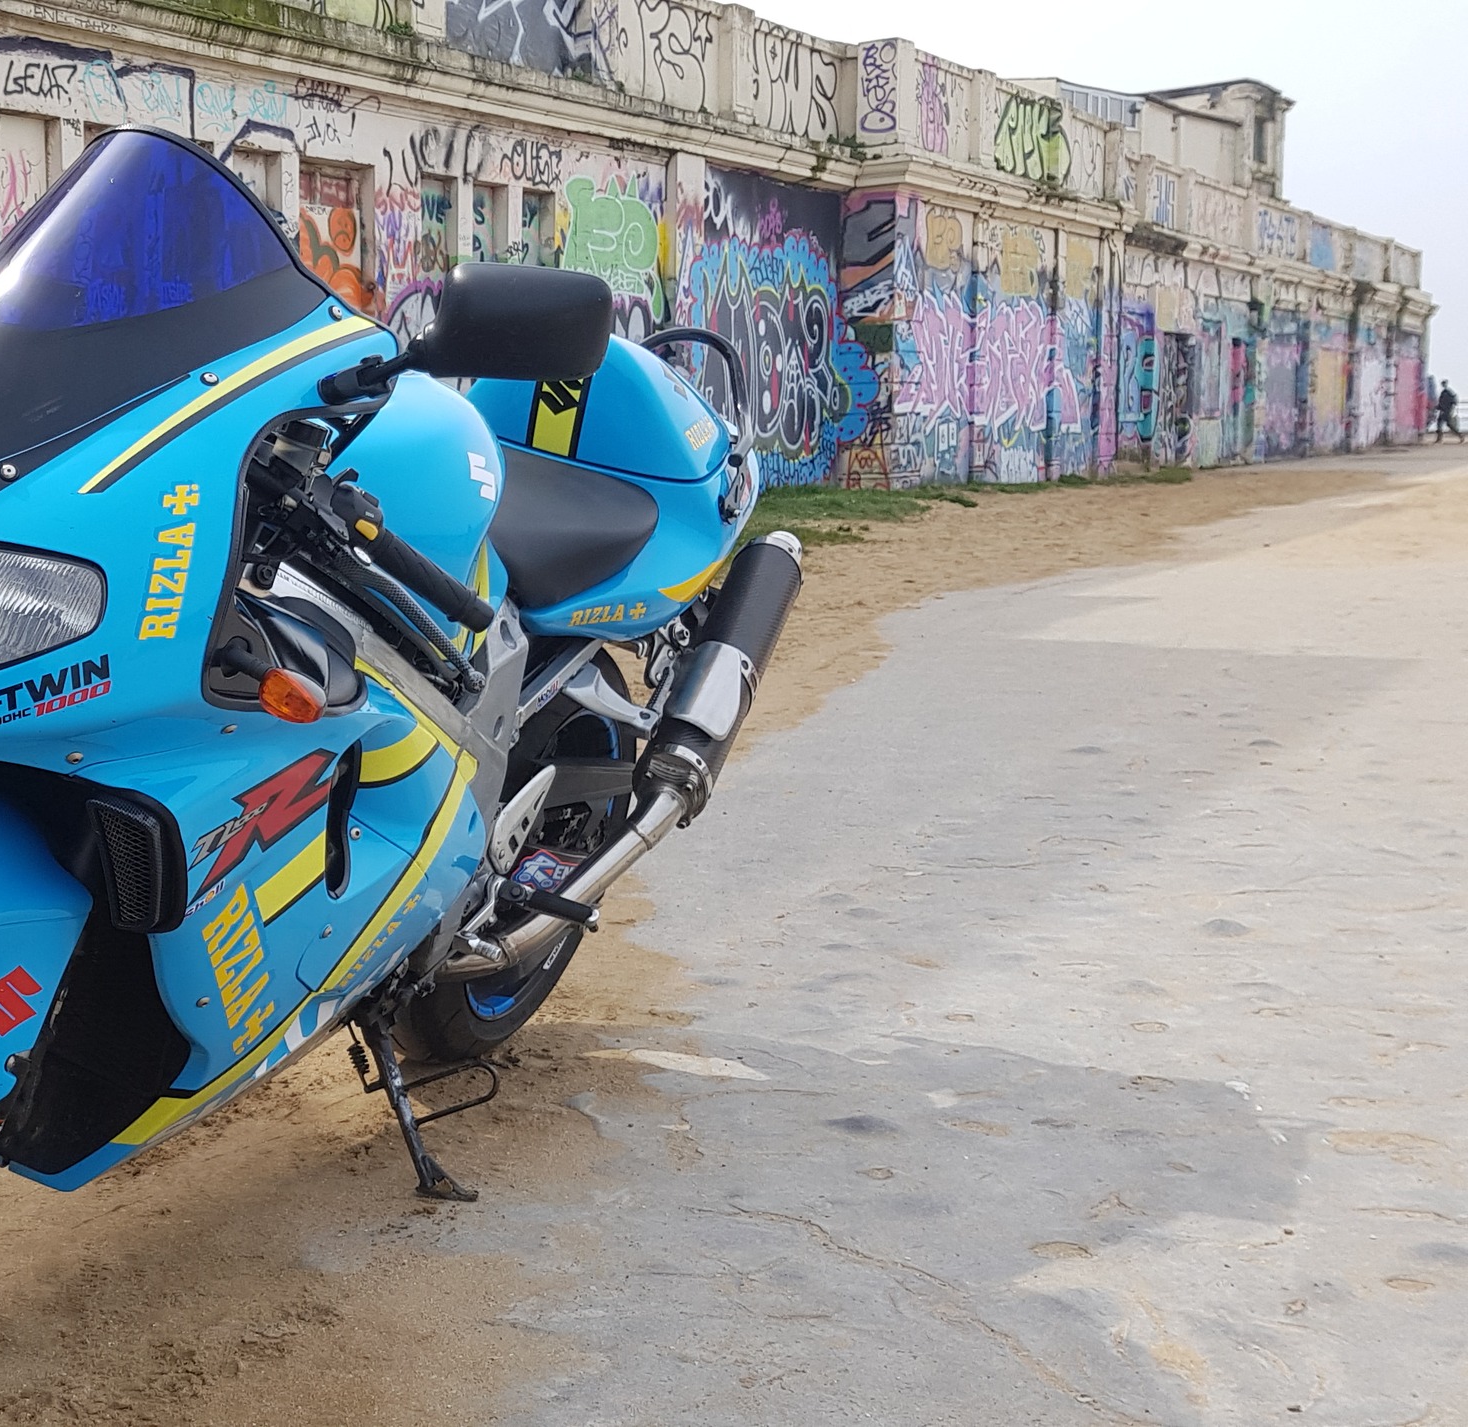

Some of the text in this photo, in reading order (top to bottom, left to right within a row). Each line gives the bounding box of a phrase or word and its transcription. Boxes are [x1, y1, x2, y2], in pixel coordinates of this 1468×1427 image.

[138, 522, 197, 640] RIZLA
[567, 603, 625, 627] RIZLA
[33, 680, 112, 717] 1000
[201, 882, 269, 1029] RIZLA
